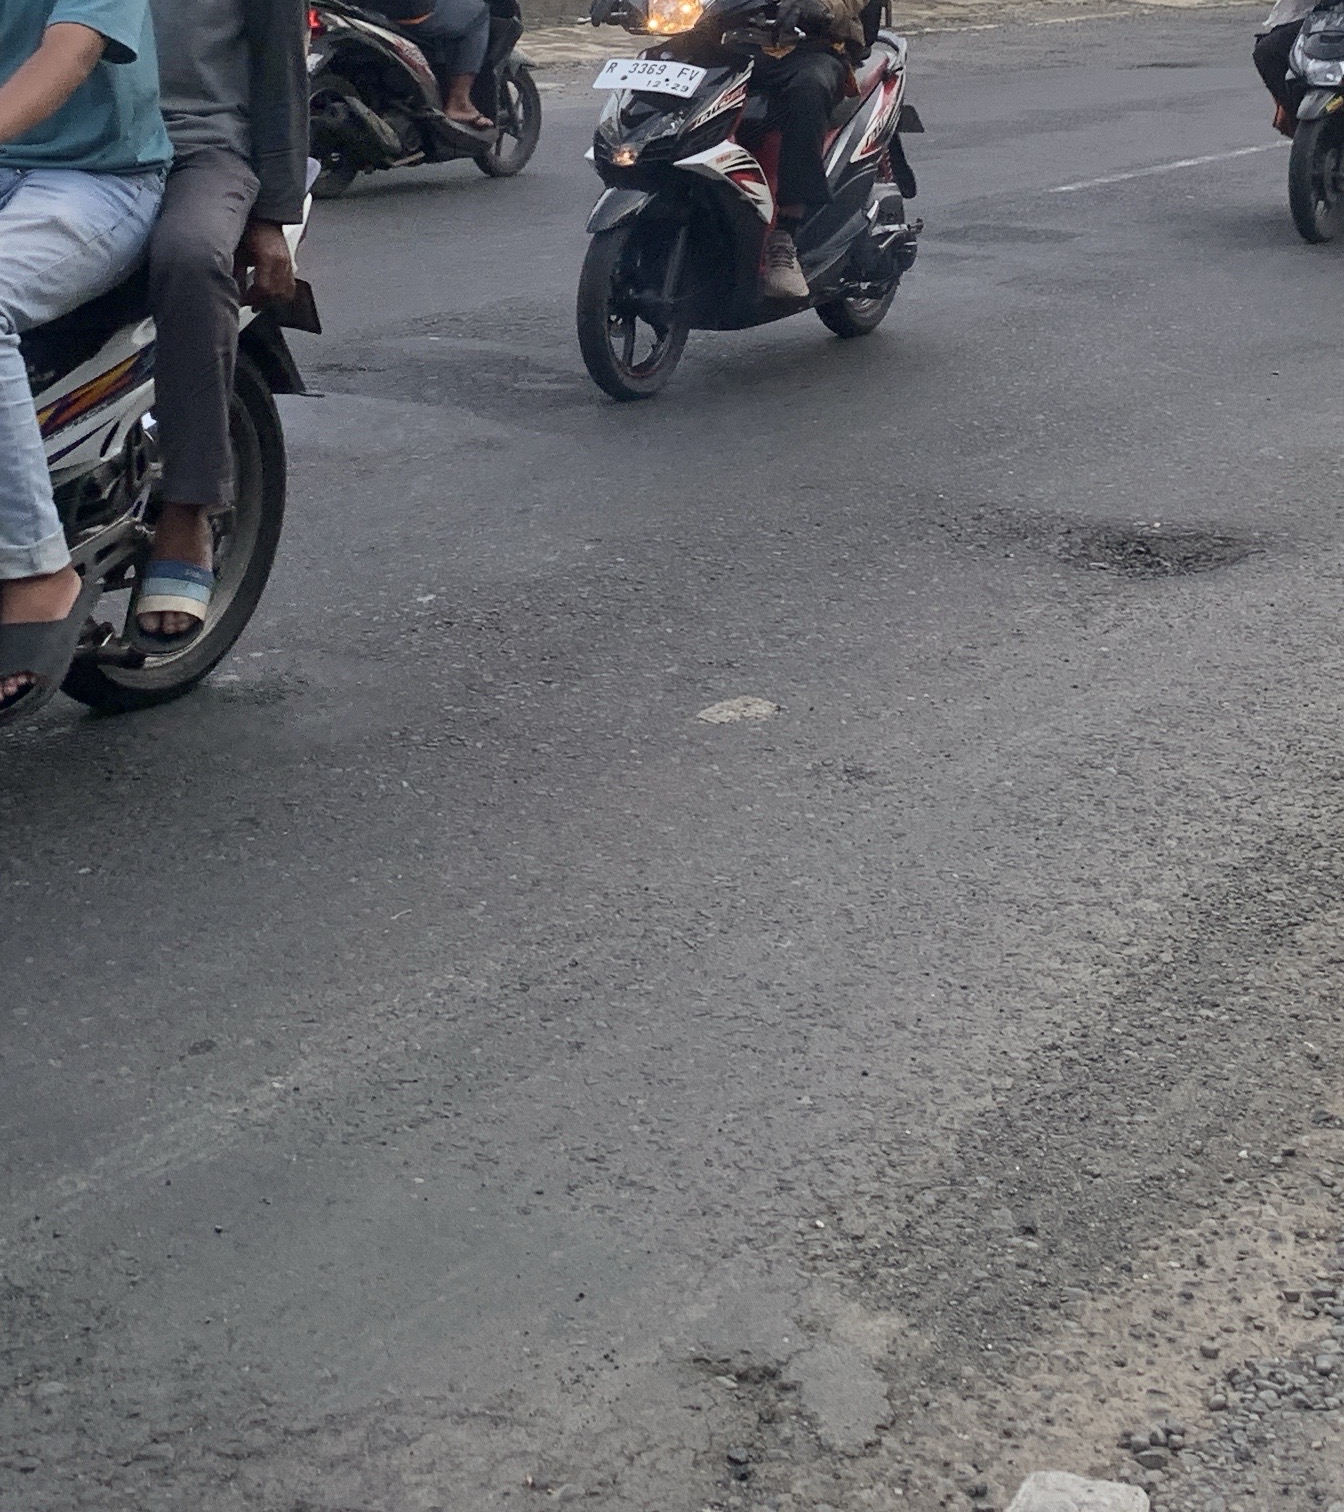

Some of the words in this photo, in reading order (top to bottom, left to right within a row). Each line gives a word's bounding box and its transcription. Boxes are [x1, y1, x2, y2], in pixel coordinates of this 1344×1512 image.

[606, 62, 618, 74] R
[628, 62, 667, 76] 3369
[677, 67, 701, 81] FV
